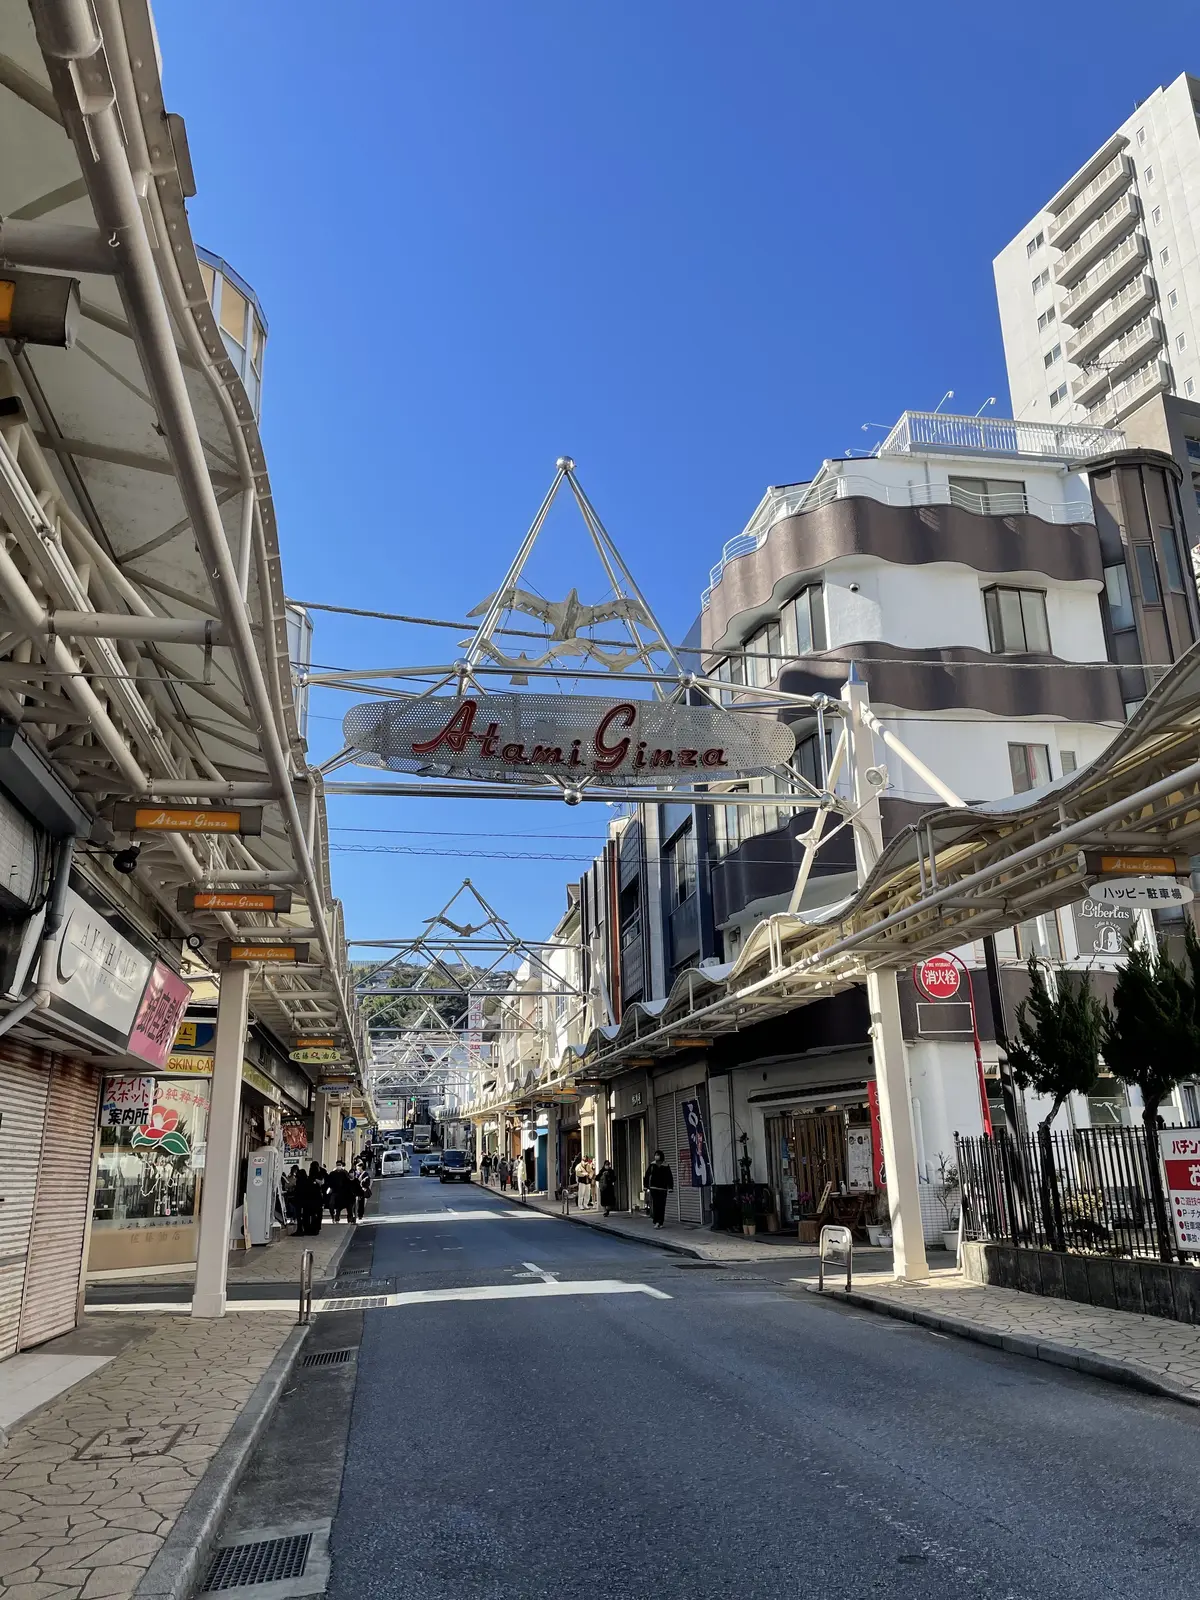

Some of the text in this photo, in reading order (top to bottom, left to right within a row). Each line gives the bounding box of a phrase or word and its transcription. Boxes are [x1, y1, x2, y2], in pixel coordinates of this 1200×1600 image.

[412, 699, 729, 772] Atami Ginza
[150, 812, 228, 828] Atami Ginza
[1111, 859, 1168, 871] Atami Ginza
[1103, 887, 1183, 900] ハッピー駐車場
[204, 895, 264, 908] Atami Ginza
[1077, 899, 1130, 919] Libertas
[238, 947, 288, 958] Atami Ginza
[924, 969, 957, 985] 消火栓
[168, 1057, 193, 1071] SKIN
[116, 1077, 146, 1091] ナイト
[107, 1089, 149, 1102] スポット
[108, 1107, 149, 1125] 案内所
[1172, 1139, 1200, 1154] パチン
